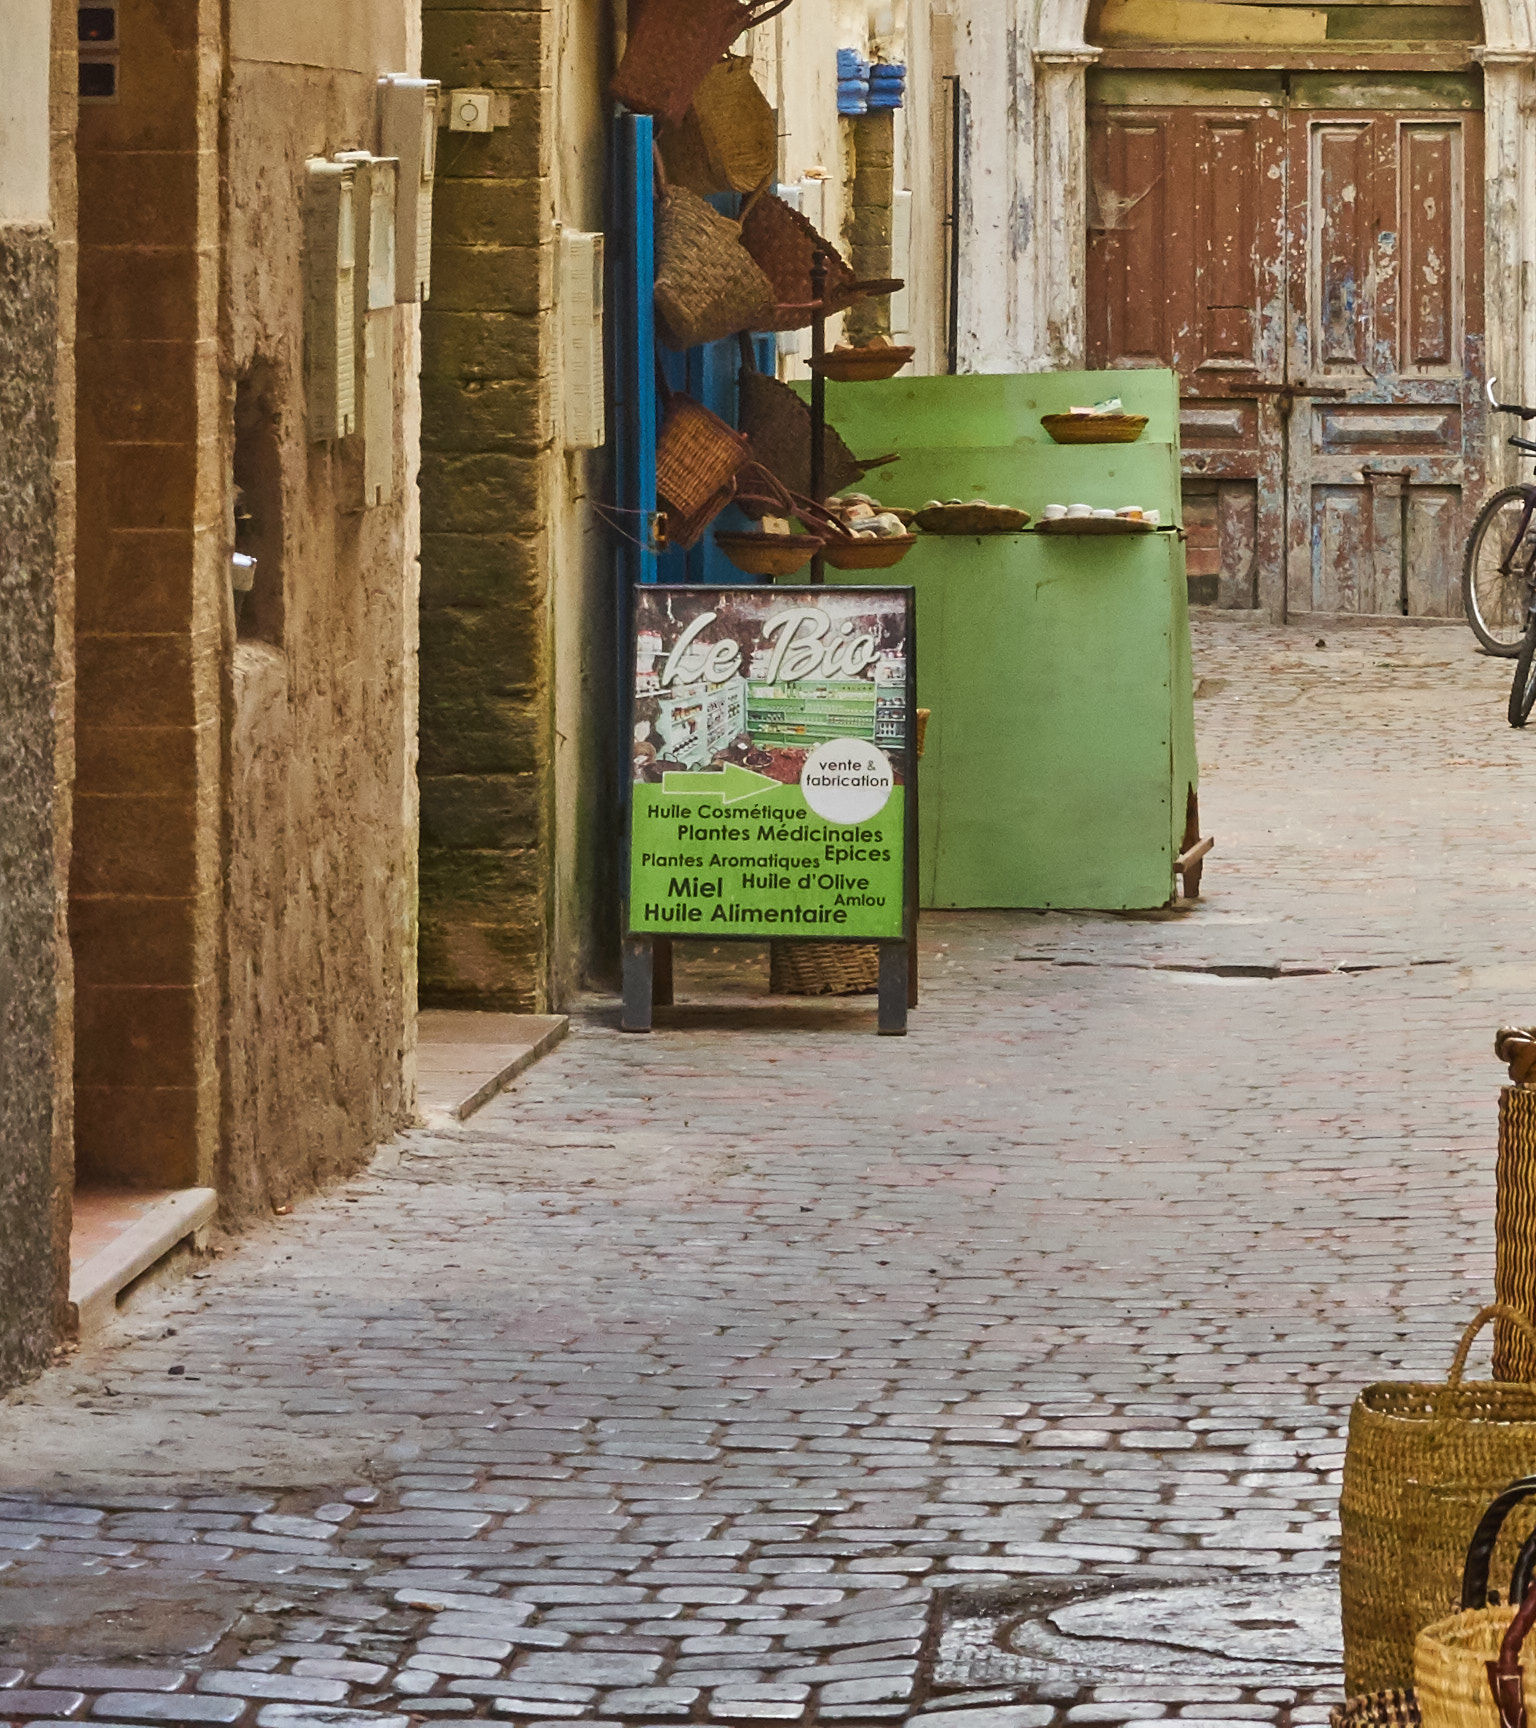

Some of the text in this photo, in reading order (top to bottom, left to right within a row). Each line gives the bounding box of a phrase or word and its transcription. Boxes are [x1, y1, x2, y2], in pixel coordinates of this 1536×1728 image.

[661, 606, 882, 687] Le Bio
[819, 759, 877, 772] vente &
[806, 774, 890, 788] fabrication
[647, 802, 807, 823] Huile Cosmétique
[677, 823, 883, 844] Plantes Médicinales
[641, 852, 820, 871] Plantes Aromatiques
[824, 844, 891, 865] Epices
[667, 877, 724, 898] Miel
[742, 873, 870, 891] Huile d'Olive
[833, 893, 886, 908] Amlou
[644, 903, 848, 924] Huile Alimentaire
